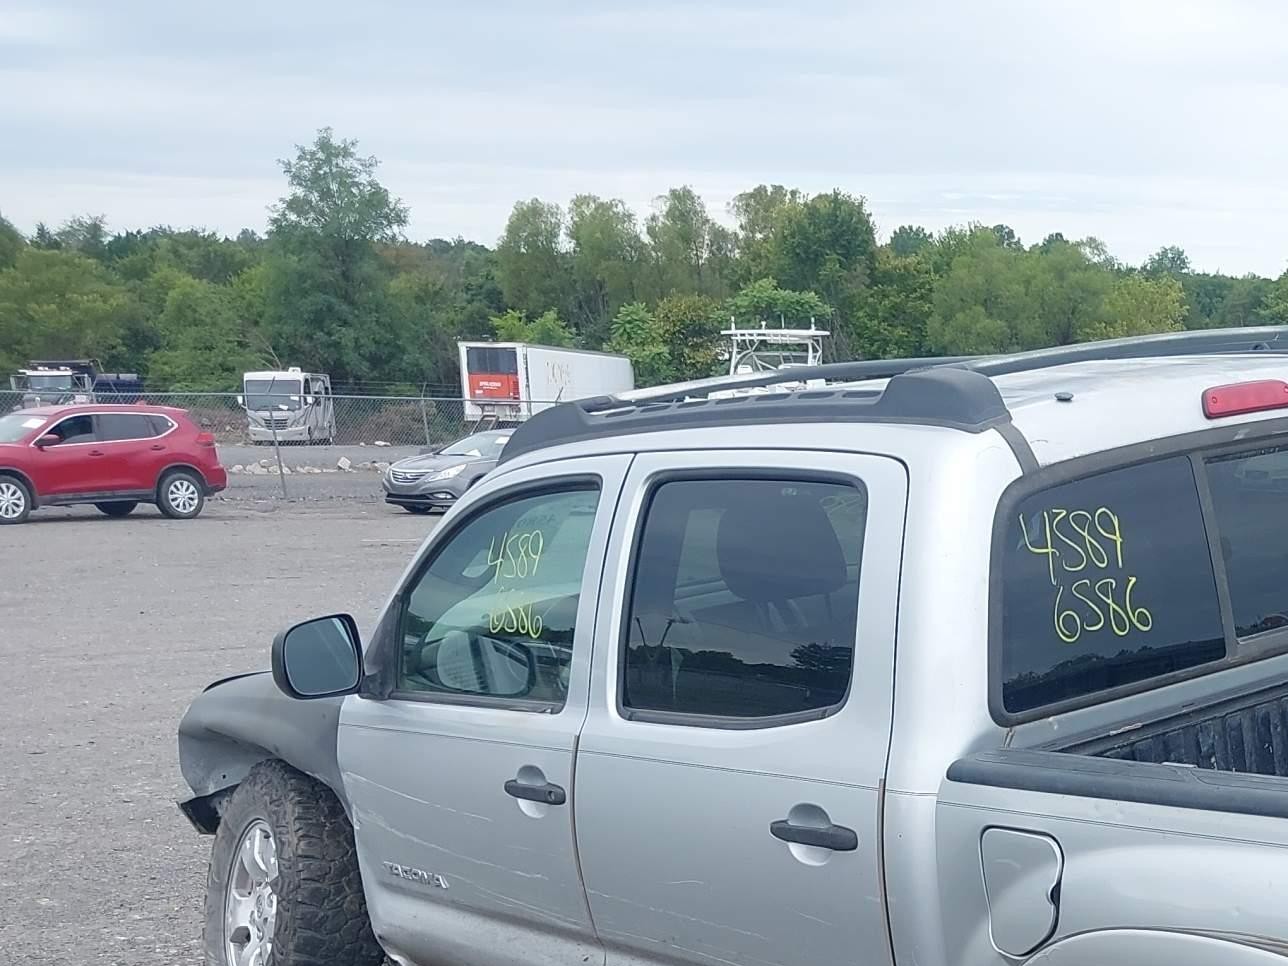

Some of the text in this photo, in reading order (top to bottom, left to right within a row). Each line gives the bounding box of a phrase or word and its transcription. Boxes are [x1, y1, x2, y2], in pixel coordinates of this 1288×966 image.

[488, 530, 543, 583] 4589
[1019, 507, 1123, 586] 4589
[1055, 576, 1153, 642] 6586
